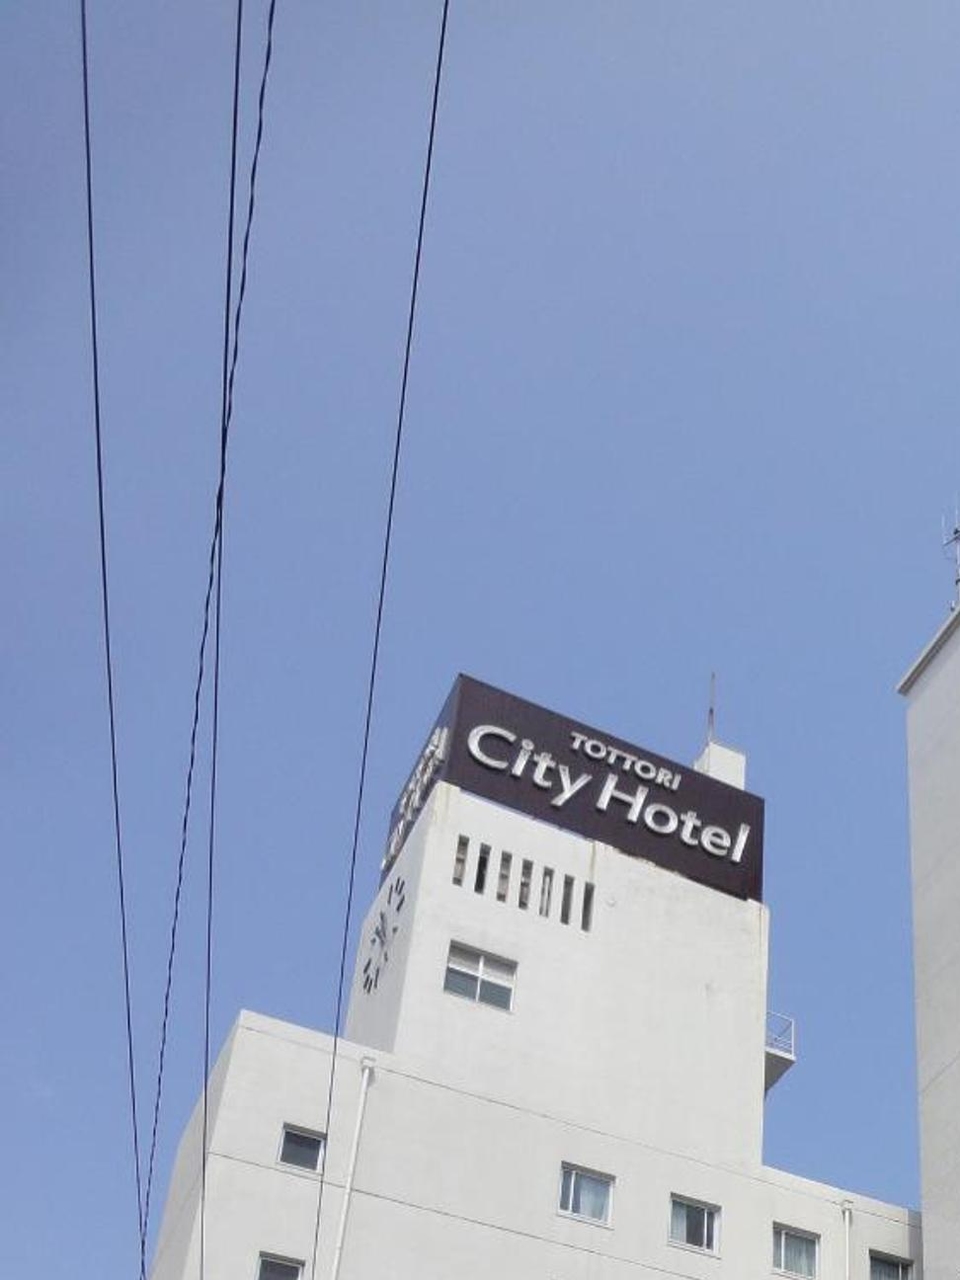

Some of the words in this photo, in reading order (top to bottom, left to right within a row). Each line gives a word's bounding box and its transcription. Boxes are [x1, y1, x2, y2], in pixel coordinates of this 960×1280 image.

[467, 725, 593, 807] City
[596, 774, 751, 863] Hotel
[570, 731, 681, 791] TOTTORI
